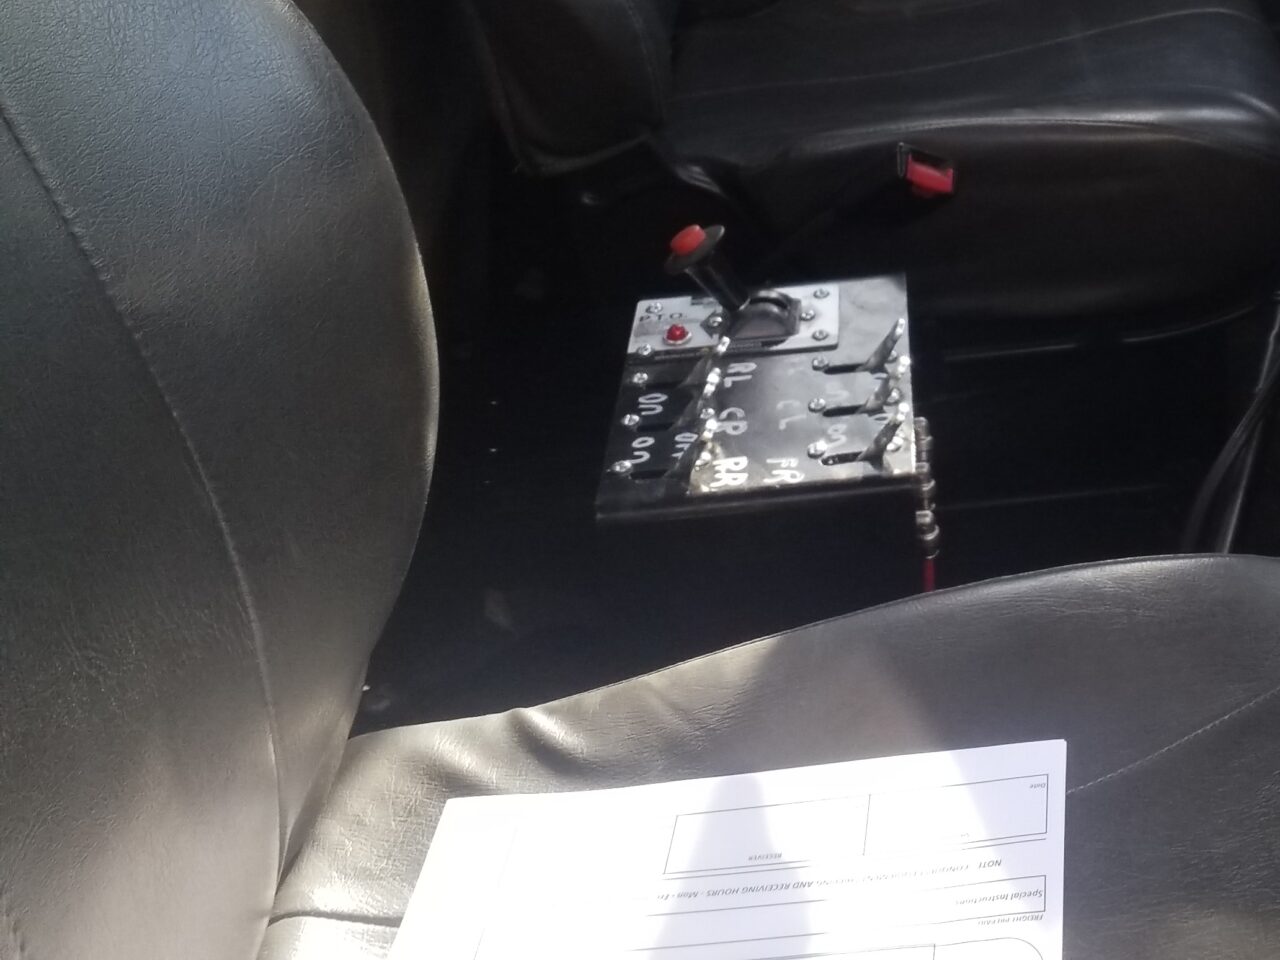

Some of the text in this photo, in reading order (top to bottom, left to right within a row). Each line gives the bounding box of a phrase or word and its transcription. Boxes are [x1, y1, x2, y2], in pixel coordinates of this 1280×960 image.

[723, 362, 758, 388] RL
[710, 456, 749, 487] RR
[742, 883, 791, 894] RECEIVING
[792, 880, 813, 889] AND
[706, 887, 740, 897] HOURS
[1011, 888, 1044, 901] Special
